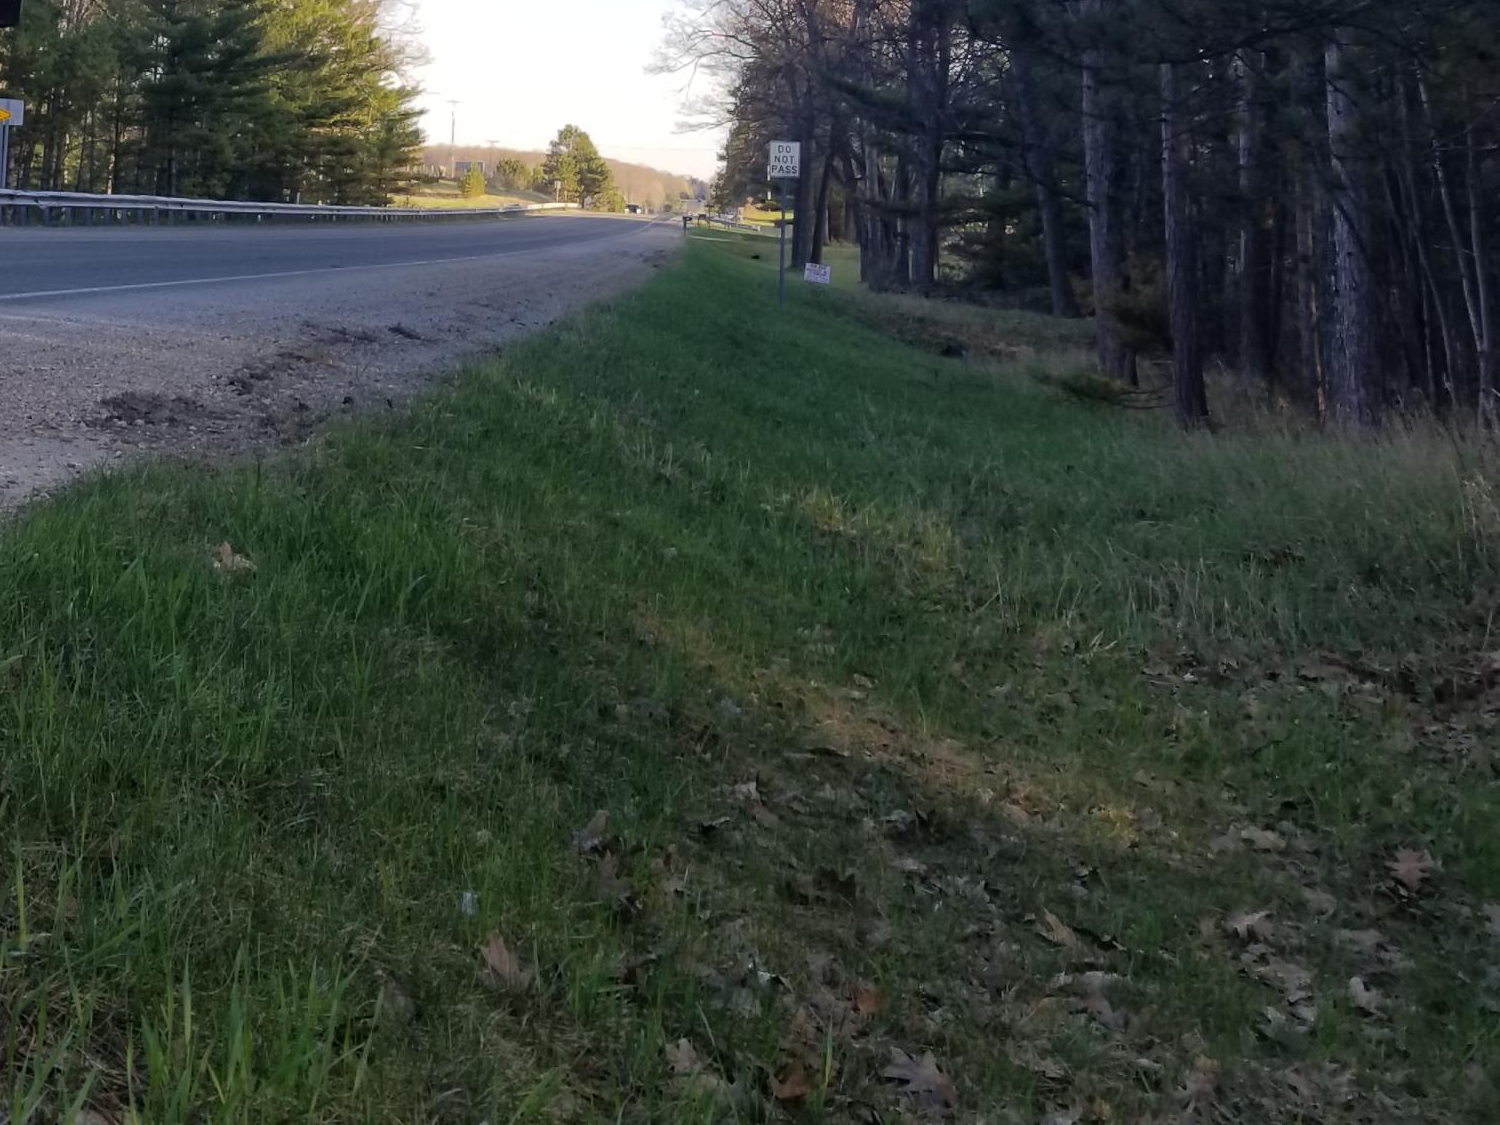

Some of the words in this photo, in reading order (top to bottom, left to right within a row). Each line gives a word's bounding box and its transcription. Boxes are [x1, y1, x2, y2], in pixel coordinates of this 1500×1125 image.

[778, 144, 792, 153] DO
[774, 155, 795, 164] NOT
[771, 164, 797, 174] PASS
